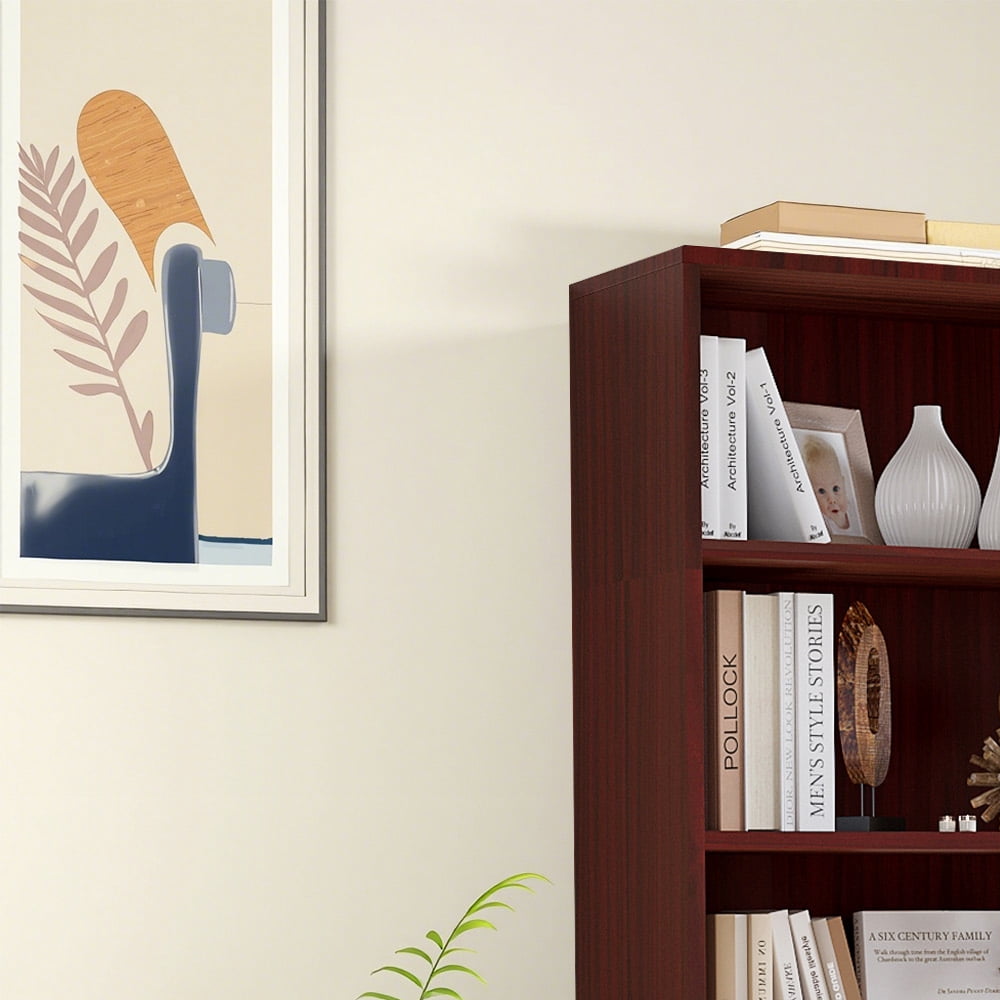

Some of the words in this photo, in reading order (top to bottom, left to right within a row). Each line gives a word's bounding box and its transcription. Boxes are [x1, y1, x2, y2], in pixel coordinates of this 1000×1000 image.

[700, 369, 708, 403] Vol-3
[727, 371, 736, 407] Vol-2
[759, 382, 776, 416] Vol-1
[700, 409, 709, 489] Architecture
[727, 412, 736, 490] Architecture
[774, 419, 805, 493] Architecture
[783, 599, 793, 696] REVOLUTION
[808, 603, 823, 689] STORIES
[722, 653, 739, 770] POLLOCK
[784, 701, 793, 743] LOOK
[809, 692, 824, 754] STYLE
[785, 747, 793, 781] NEW
[809, 757, 825, 818] MEN'S
[869, 932, 876, 941] A
[878, 931, 896, 941] SIX
[897, 931, 950, 941] CENTURY
[952, 930, 993, 941] FAMILY
[889, 949, 910, 957] through
